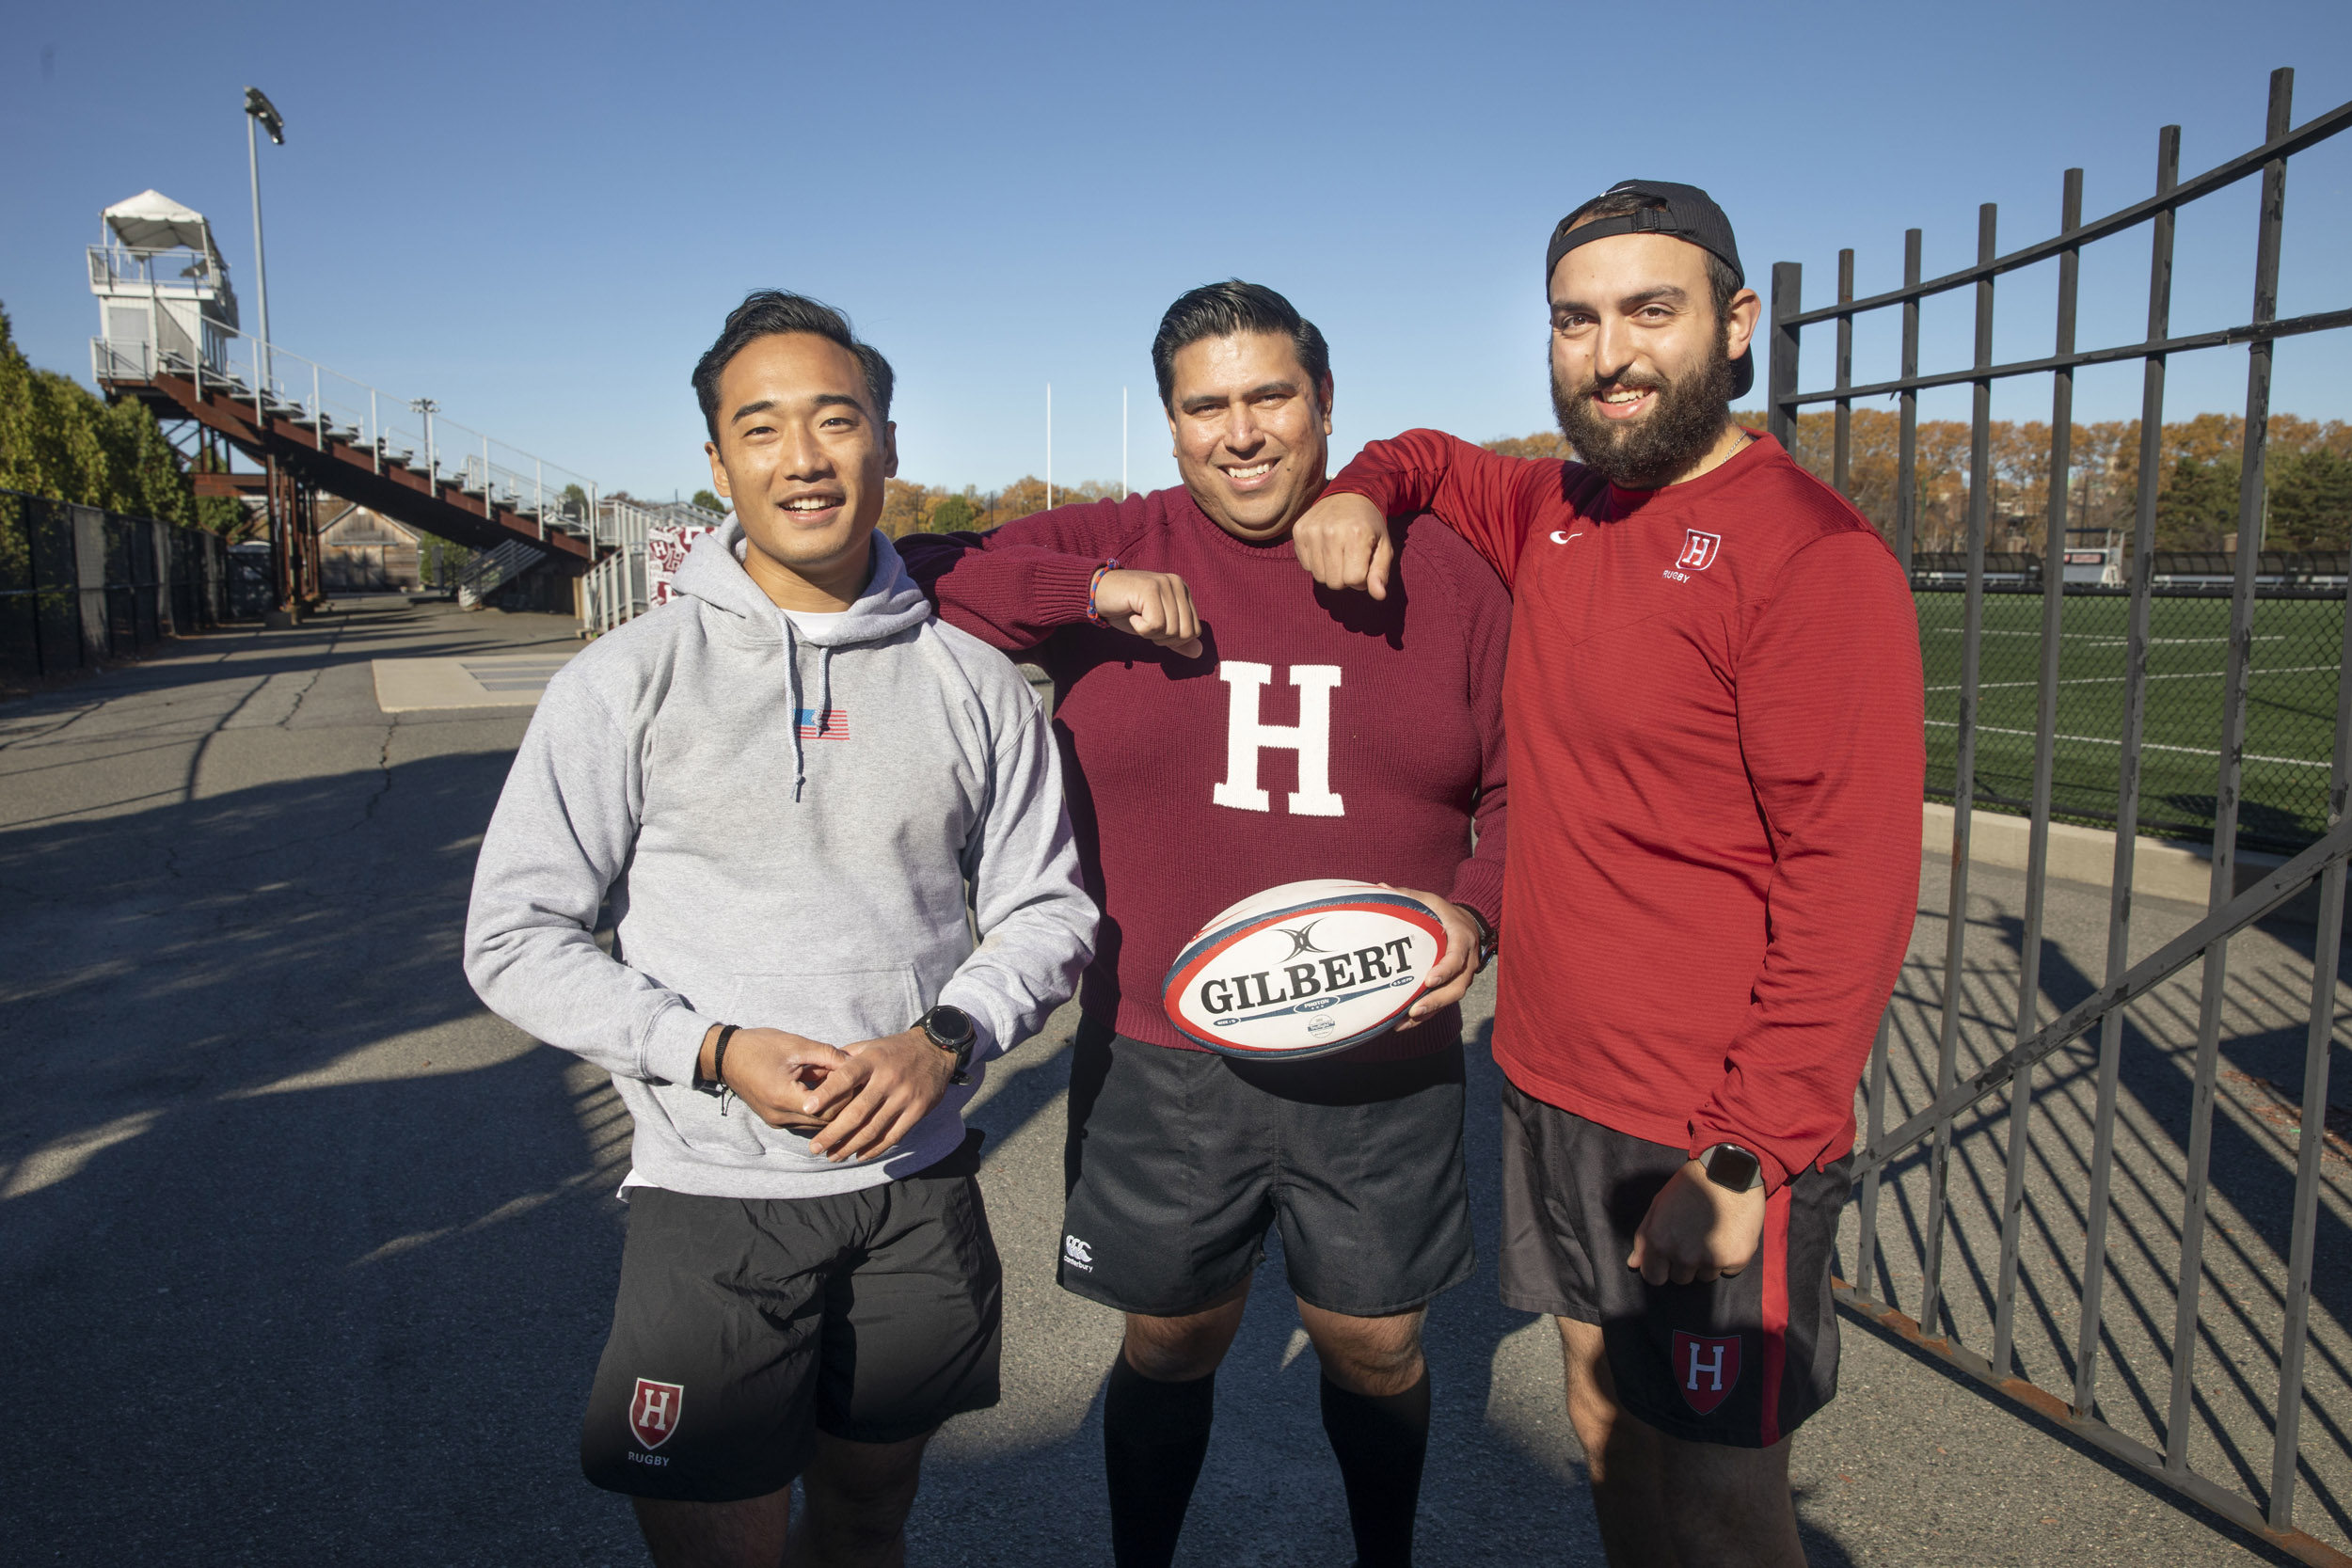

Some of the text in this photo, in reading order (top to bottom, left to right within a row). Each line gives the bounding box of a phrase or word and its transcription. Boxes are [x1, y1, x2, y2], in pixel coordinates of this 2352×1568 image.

[653, 541, 667, 558] H
[1682, 536, 1710, 566] H
[1662, 569, 1691, 584] RUGBY
[1213, 660, 1345, 816] H
[1200, 936, 1413, 1014] GILBERT
[1304, 998, 1329, 1008] PHOTON
[1686, 1341, 1724, 1391] H
[638, 1387, 670, 1431] H
[628, 1451, 670, 1466] RUGBY
